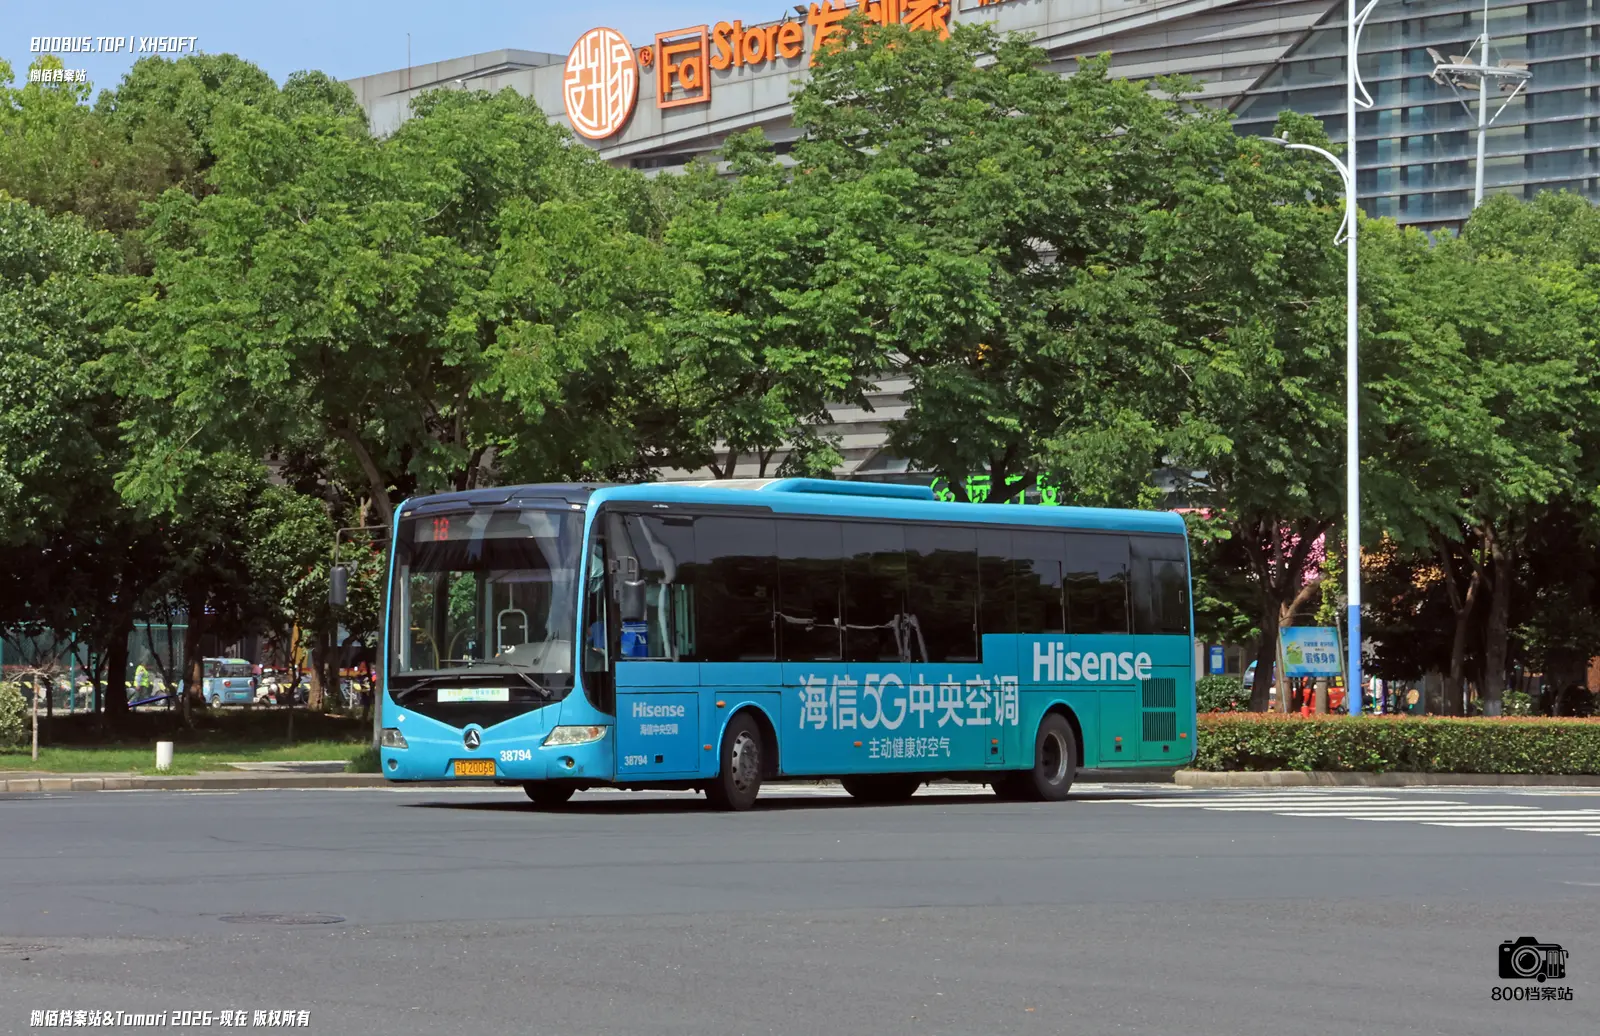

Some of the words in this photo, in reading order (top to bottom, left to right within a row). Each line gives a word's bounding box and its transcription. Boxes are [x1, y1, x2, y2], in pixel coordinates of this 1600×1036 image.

[662, 41, 703, 93] Fa
[710, 20, 804, 70] Store
[1032, 641, 1153, 682] Hisense
[632, 702, 685, 718] Hisense
[798, 673, 1020, 731] 海信5G中央空调
[640, 723, 678, 736] 海信中央空调
[500, 749, 532, 762] 38794
[868, 736, 951, 759] 主动健康好空气
[624, 755, 648, 767] 38794
